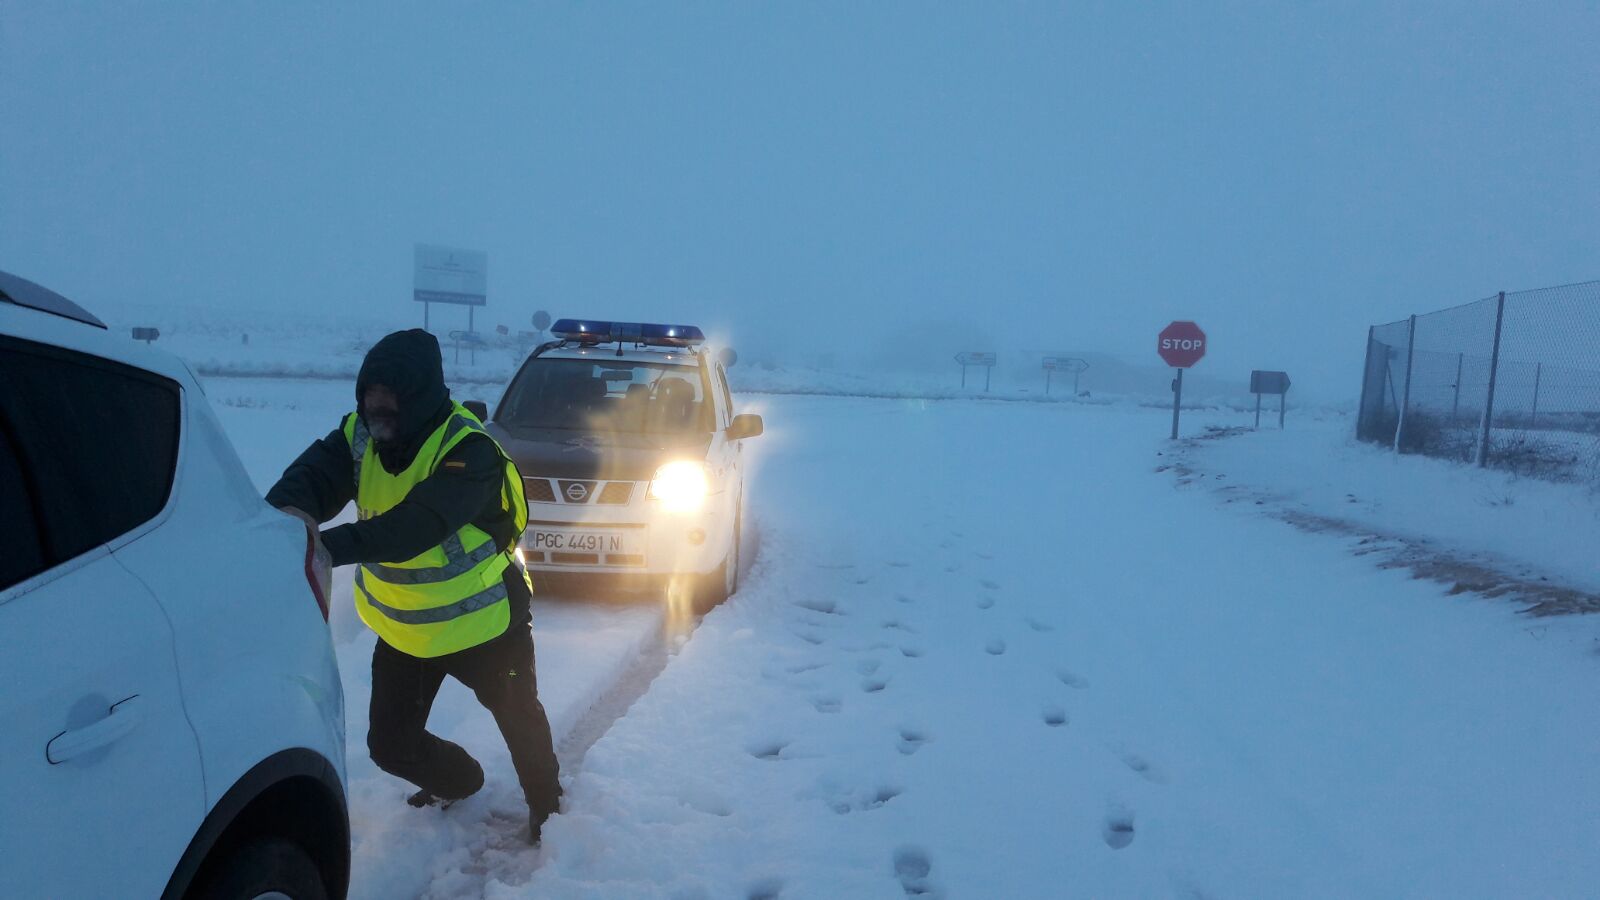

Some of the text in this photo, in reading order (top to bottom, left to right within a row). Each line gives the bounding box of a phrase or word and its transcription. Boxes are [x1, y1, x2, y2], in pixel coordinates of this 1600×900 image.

[1162, 338, 1202, 350] STOP
[535, 532, 620, 551] PGC 4491 N
